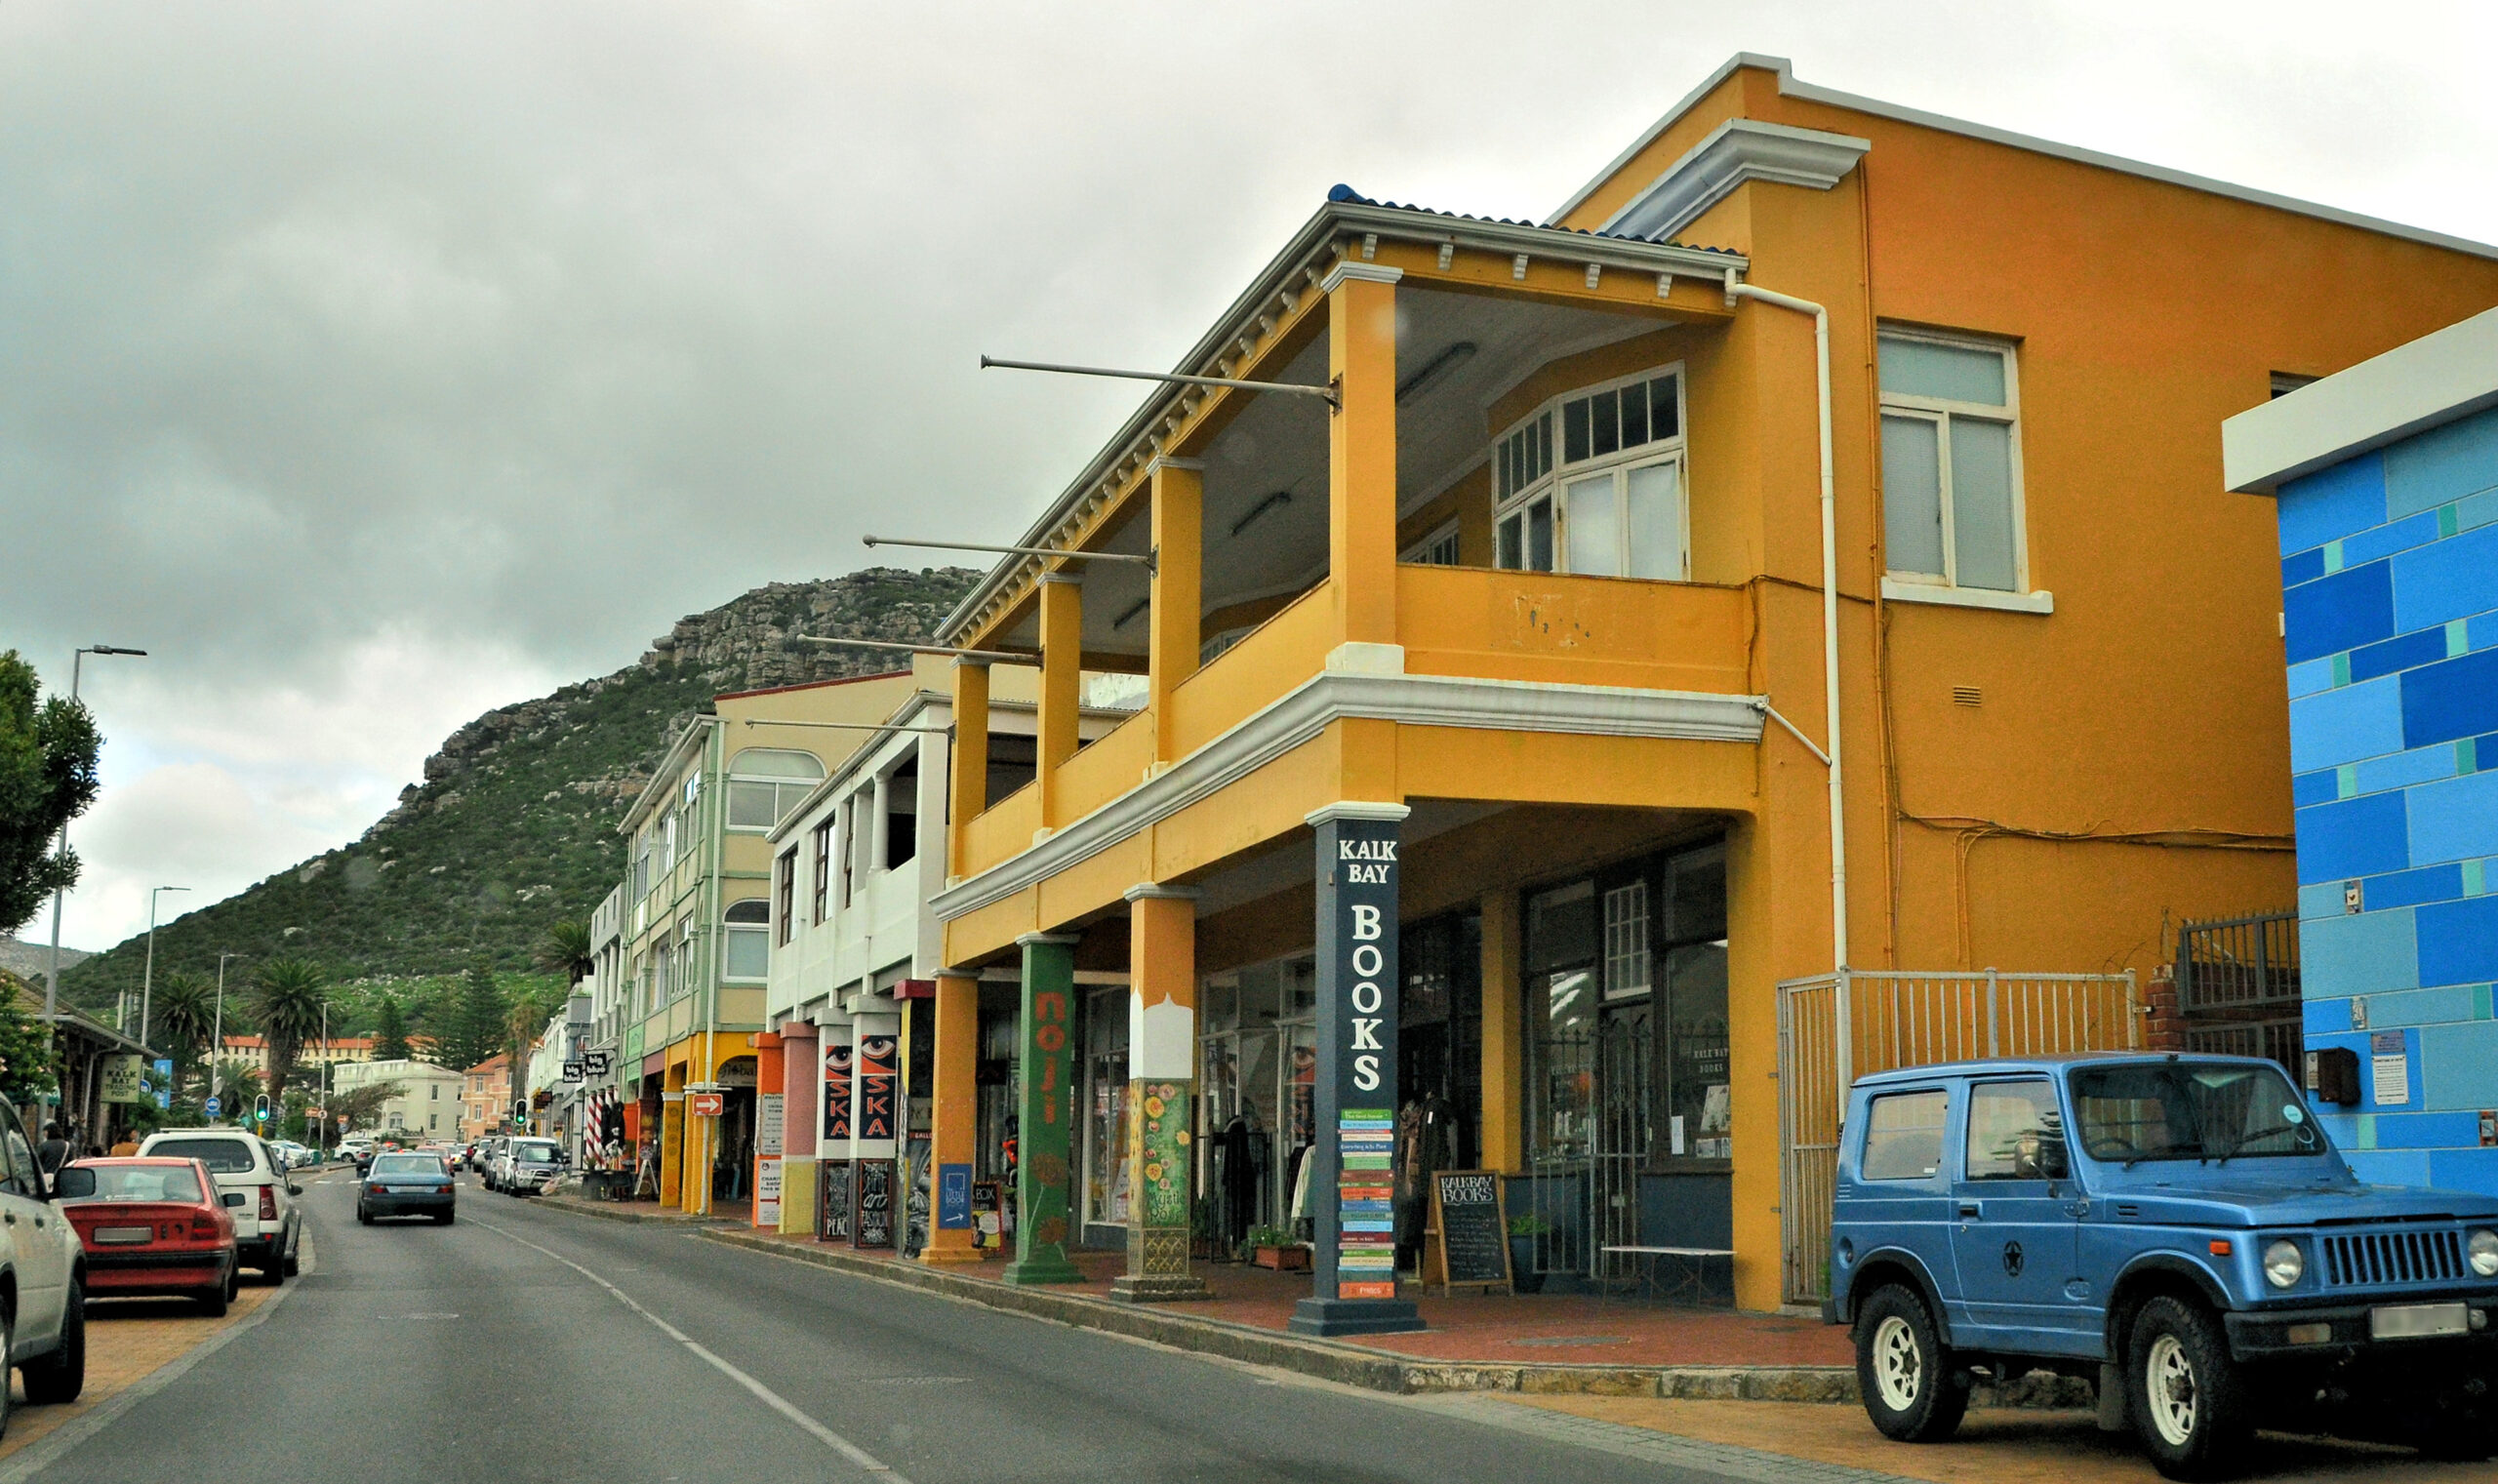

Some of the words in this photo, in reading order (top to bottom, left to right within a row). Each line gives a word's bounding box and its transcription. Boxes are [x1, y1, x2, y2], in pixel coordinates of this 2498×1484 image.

[1339, 840, 1397, 861] KALK
[1349, 864, 1390, 883] BAY
[1350, 904, 1383, 1091] BOOKS
[588, 1056, 603, 1064] big
[566, 1065, 579, 1074] big
[829, 1081, 851, 1136] SKA
[866, 1076, 889, 1136] SKA
[1440, 1177, 1469, 1188] KALK
[976, 1188, 995, 1200] BOX
[1442, 1187, 1494, 1203] BOOKS
